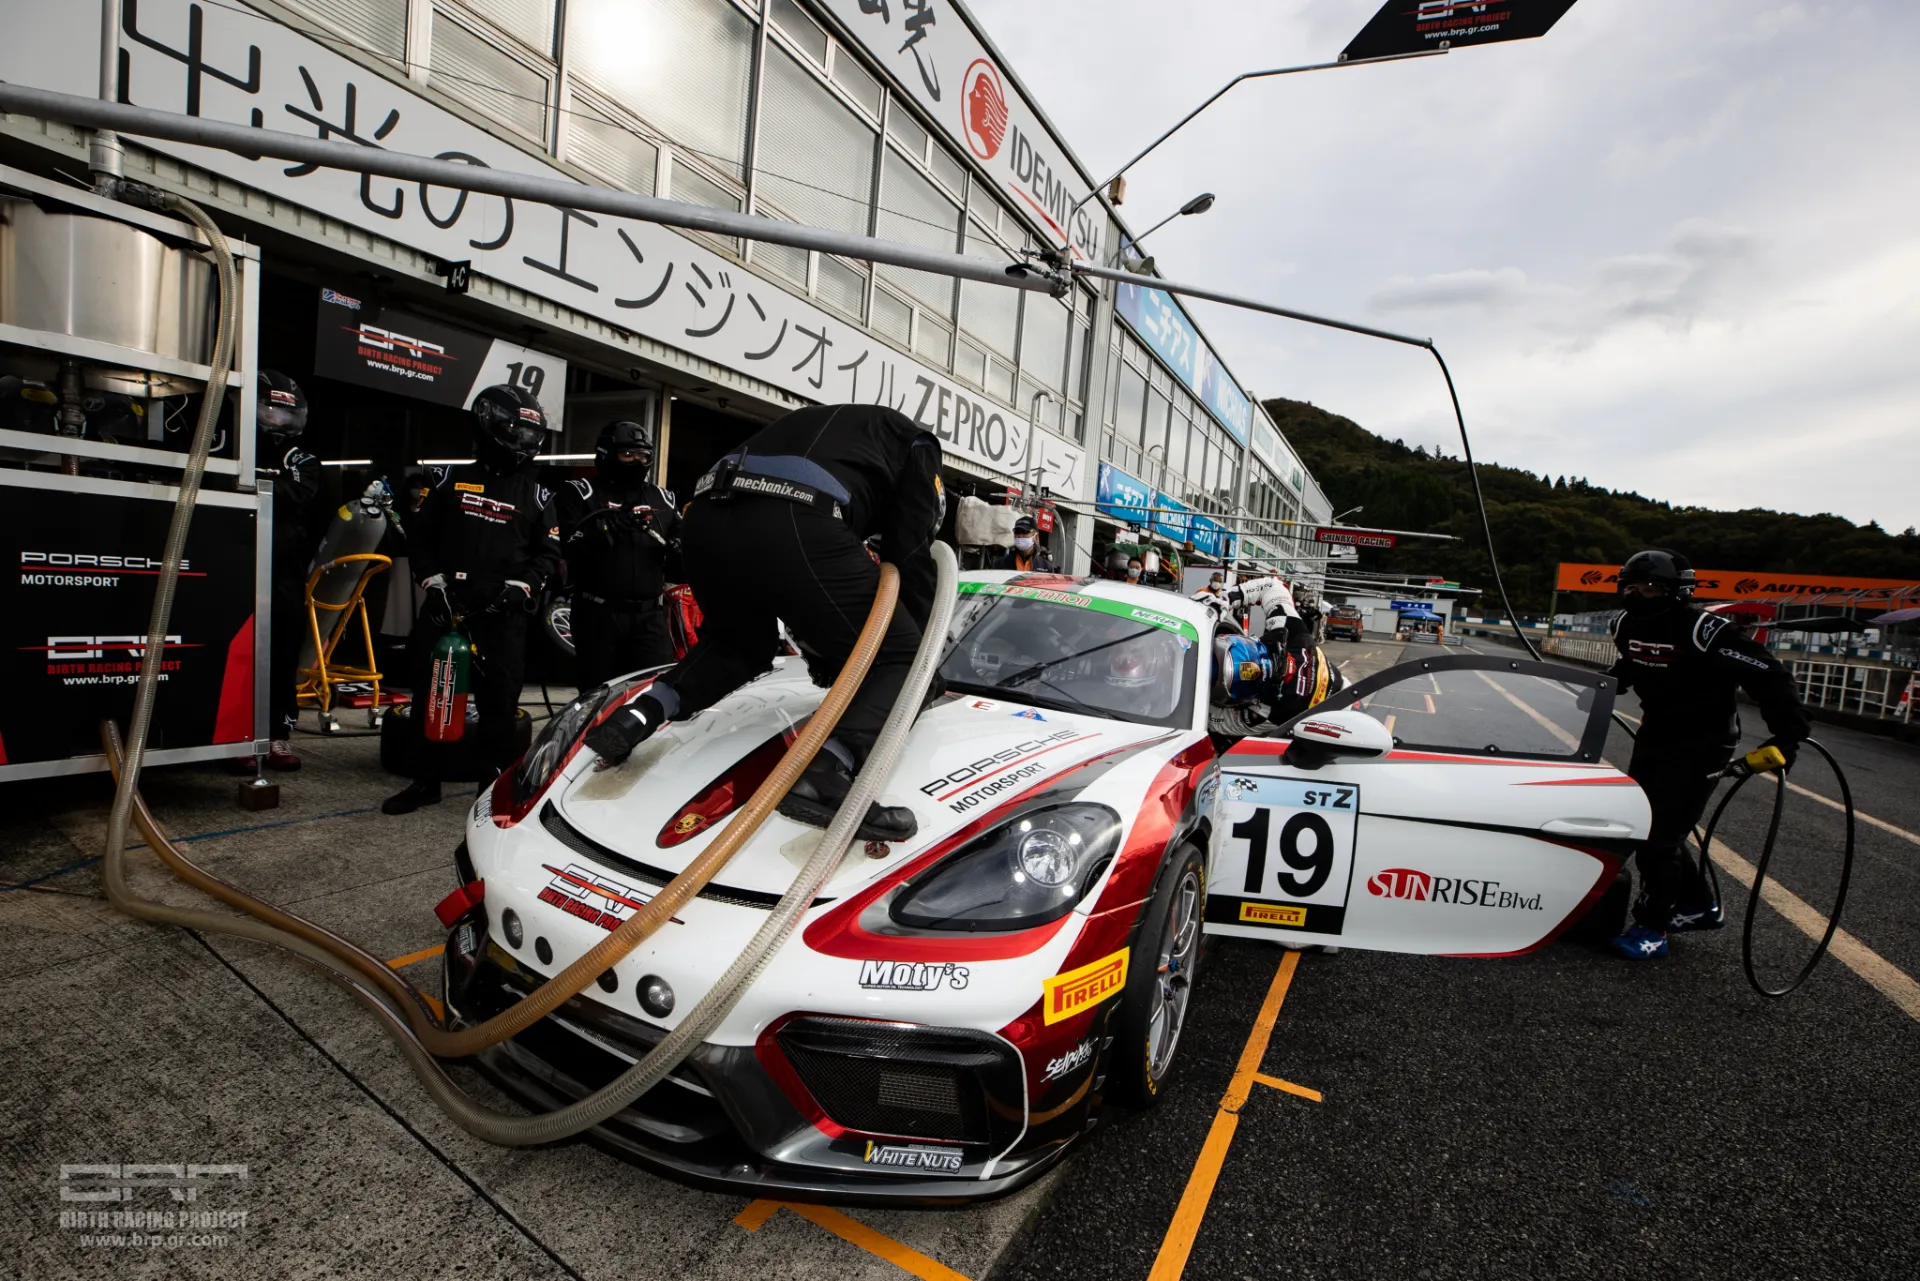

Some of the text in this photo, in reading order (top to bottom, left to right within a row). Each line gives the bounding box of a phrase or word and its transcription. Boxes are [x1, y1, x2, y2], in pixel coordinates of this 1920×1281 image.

[1424, 23, 1500, 40] www.brp.gr.com
[1475, 11, 1512, 27] PROJECT
[1009, 124, 1098, 261] IDEMITSU
[1146, 288, 1192, 373] ニチアス
[357, 345, 443, 375] BIRTH RACING PROJECT
[366, 359, 434, 382] www.brp.gr.com
[506, 361, 546, 400] 19
[732, 476, 814, 503] mechanix.com
[1320, 533, 1392, 548] SHINRYO RACING
[21, 551, 190, 571] PORSCHE
[21, 574, 121, 587] MOTORSPORT
[47, 661, 182, 675] BIRTH RACING PECT
[972, 700, 994, 711] E
[919, 729, 1080, 797] PORSCHE
[949, 762, 1047, 814] MOTORSPORT
[1232, 807, 1334, 898] 19
[1370, 870, 1544, 911] SUNRISE Blvd.
[537, 886, 569, 909] BIRTH
[561, 897, 602, 924] RACING
[1245, 906, 1301, 923] PIRELLI
[859, 960, 969, 991] Moty's
[1053, 958, 1123, 1015] PIRELLI
[917, 1152, 962, 1169] NUTS
